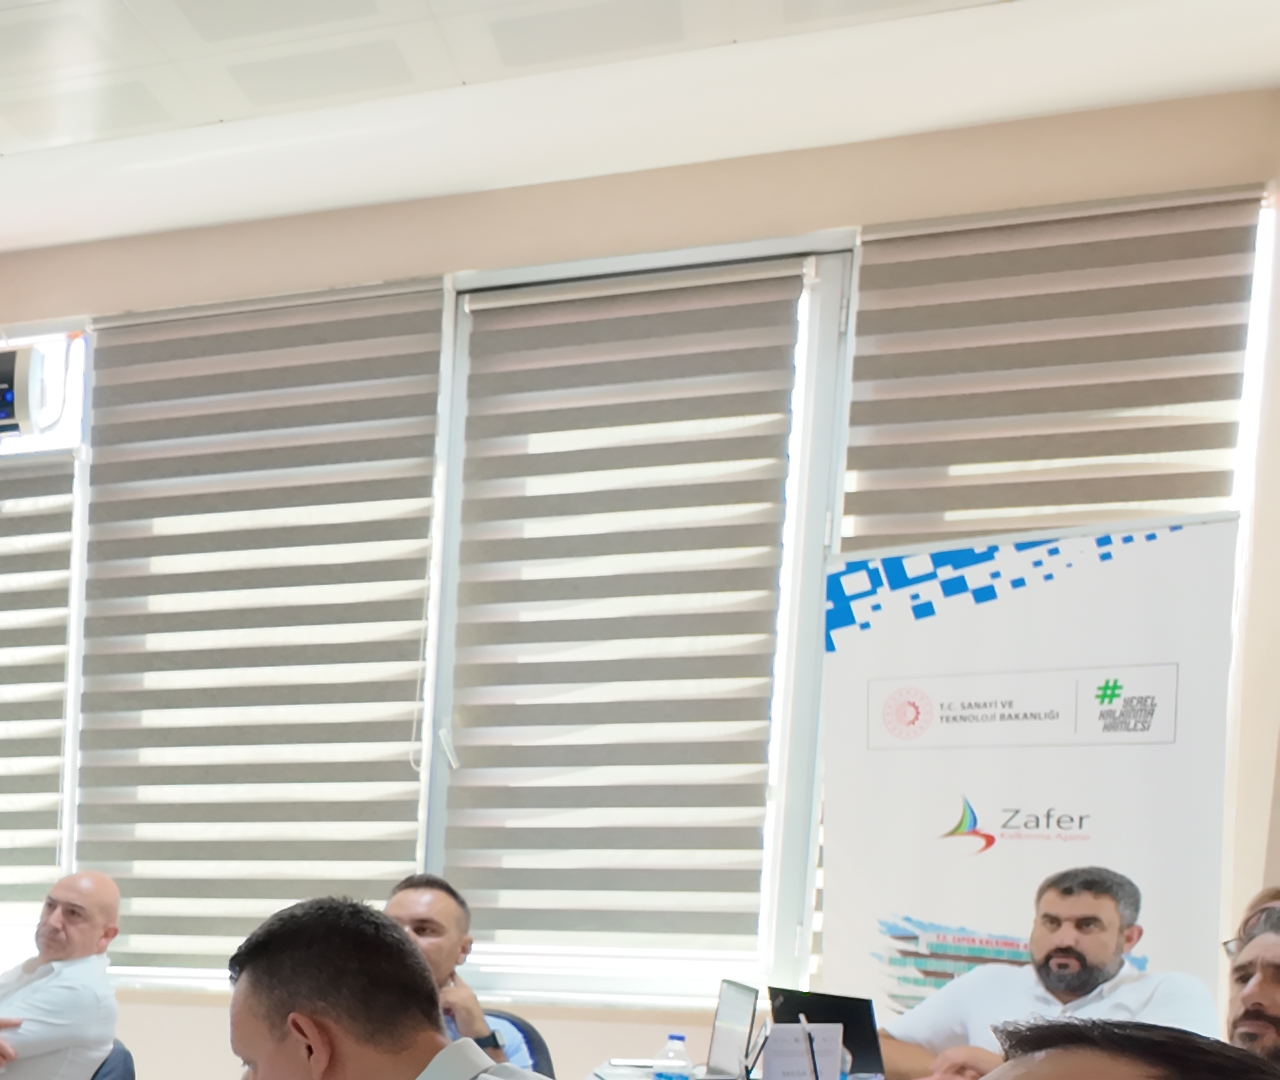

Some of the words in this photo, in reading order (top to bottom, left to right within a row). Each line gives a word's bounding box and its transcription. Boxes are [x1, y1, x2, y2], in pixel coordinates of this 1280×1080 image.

[1000, 700, 1014, 709] VE
[999, 710, 1060, 722] BAKANLIĞI
[1000, 807, 1091, 831] Zafer
